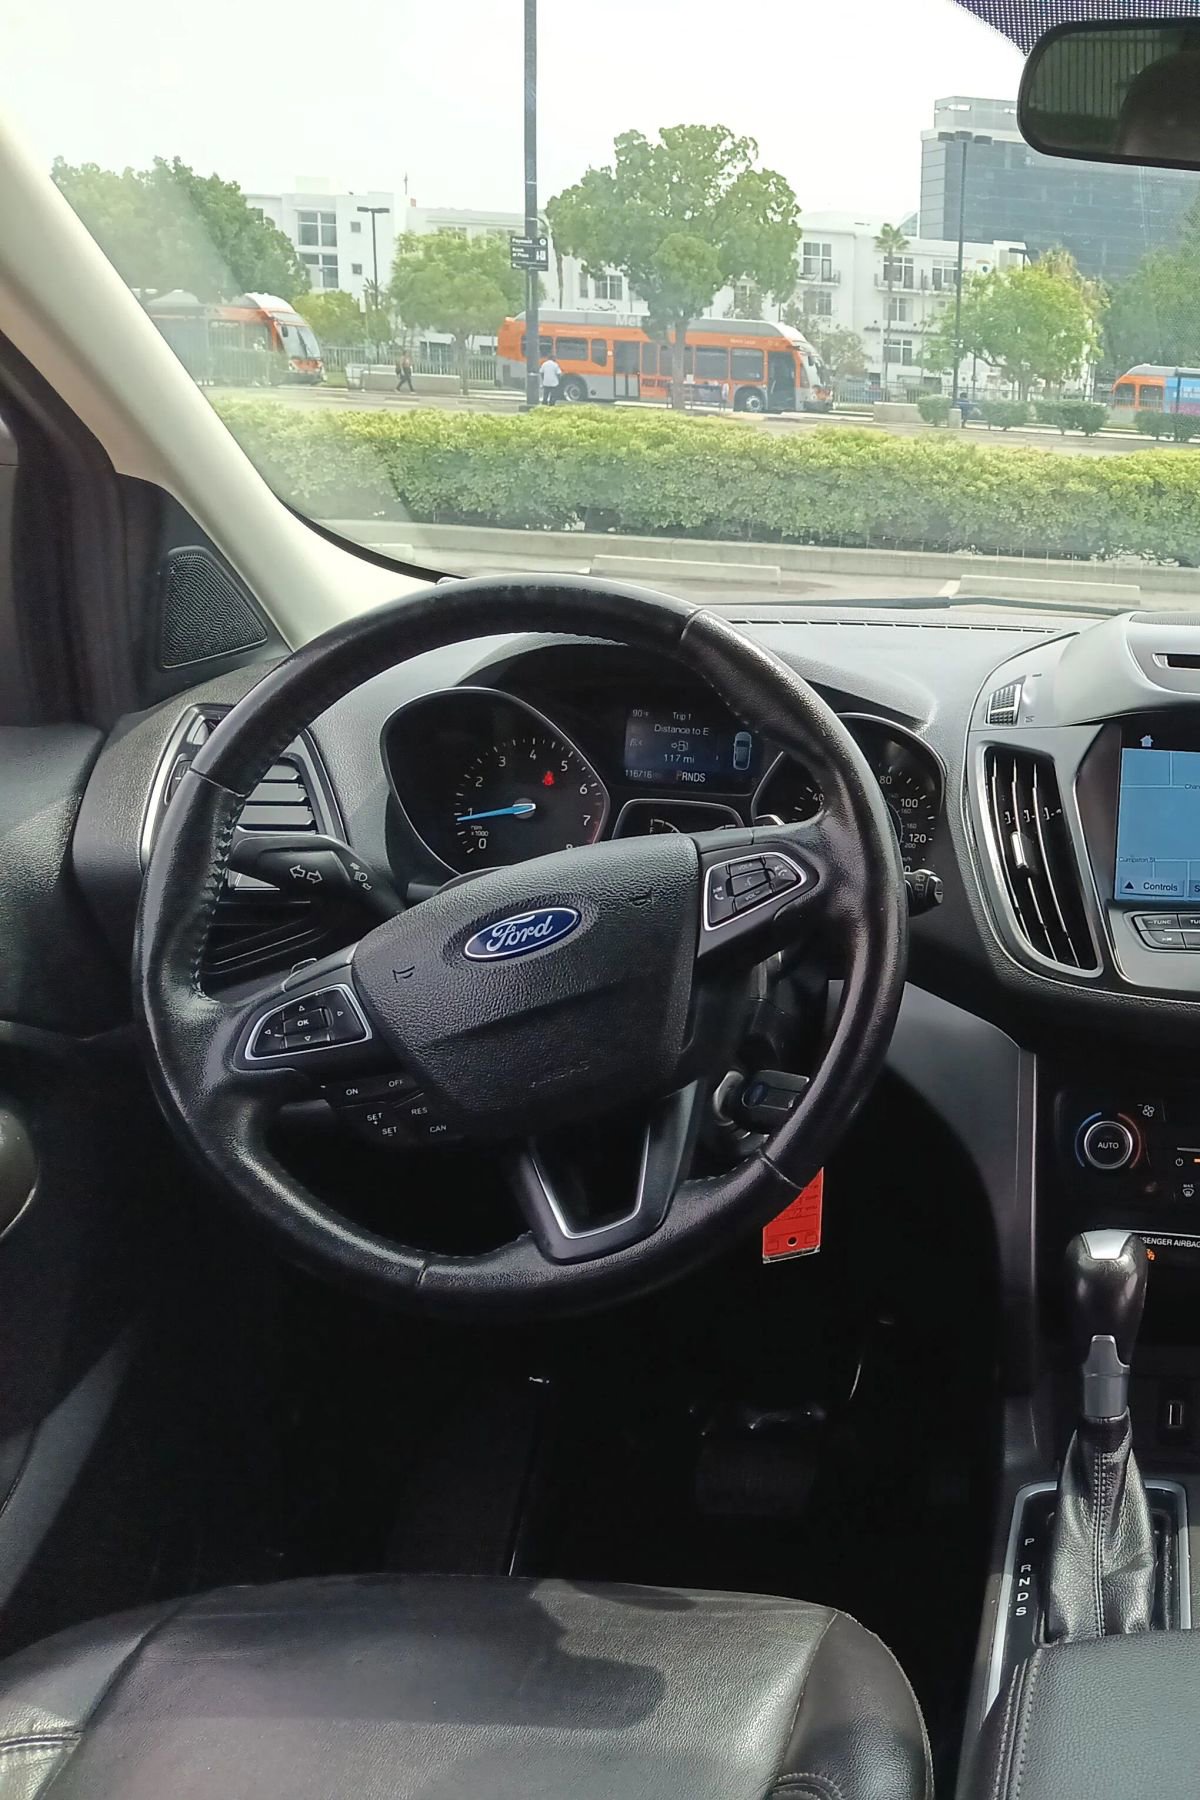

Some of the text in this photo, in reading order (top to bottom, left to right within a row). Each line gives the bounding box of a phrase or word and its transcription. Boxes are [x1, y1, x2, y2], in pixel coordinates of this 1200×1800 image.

[654, 723, 710, 736] Distance to E
[529, 749, 537, 761] 4
[663, 753, 695, 764] 117 mi
[499, 756, 506, 767] 3
[560, 760, 569, 772] 5
[475, 776, 484, 788] 2
[879, 775, 893, 785] 80
[579, 784, 588, 795] 6
[901, 797, 919, 808] 100
[582, 814, 592, 826] 7
[478, 838, 487, 849] 0
[909, 833, 928, 844] 120
[1143, 881, 1178, 892] Controls
[1194, 884, 1200, 893] S
[486, 915, 553, 952] Ford
[297, 1018, 309, 1027] OK
[345, 1088, 359, 1096] ON
[411, 1106, 428, 1116] RES
[366, 1112, 383, 1122] SET
[381, 1126, 397, 1135] SET
[429, 1125, 447, 1134] CAN
[1097, 1141, 1119, 1149] AUTO
[1141, 1236, 1173, 1246] SENGER
[1024, 1537, 1035, 1546] P
[1020, 1564, 1032, 1573] R
[1018, 1576, 1031, 1587] N
[1016, 1592, 1029, 1602] D
[1015, 1606, 1027, 1616] S
